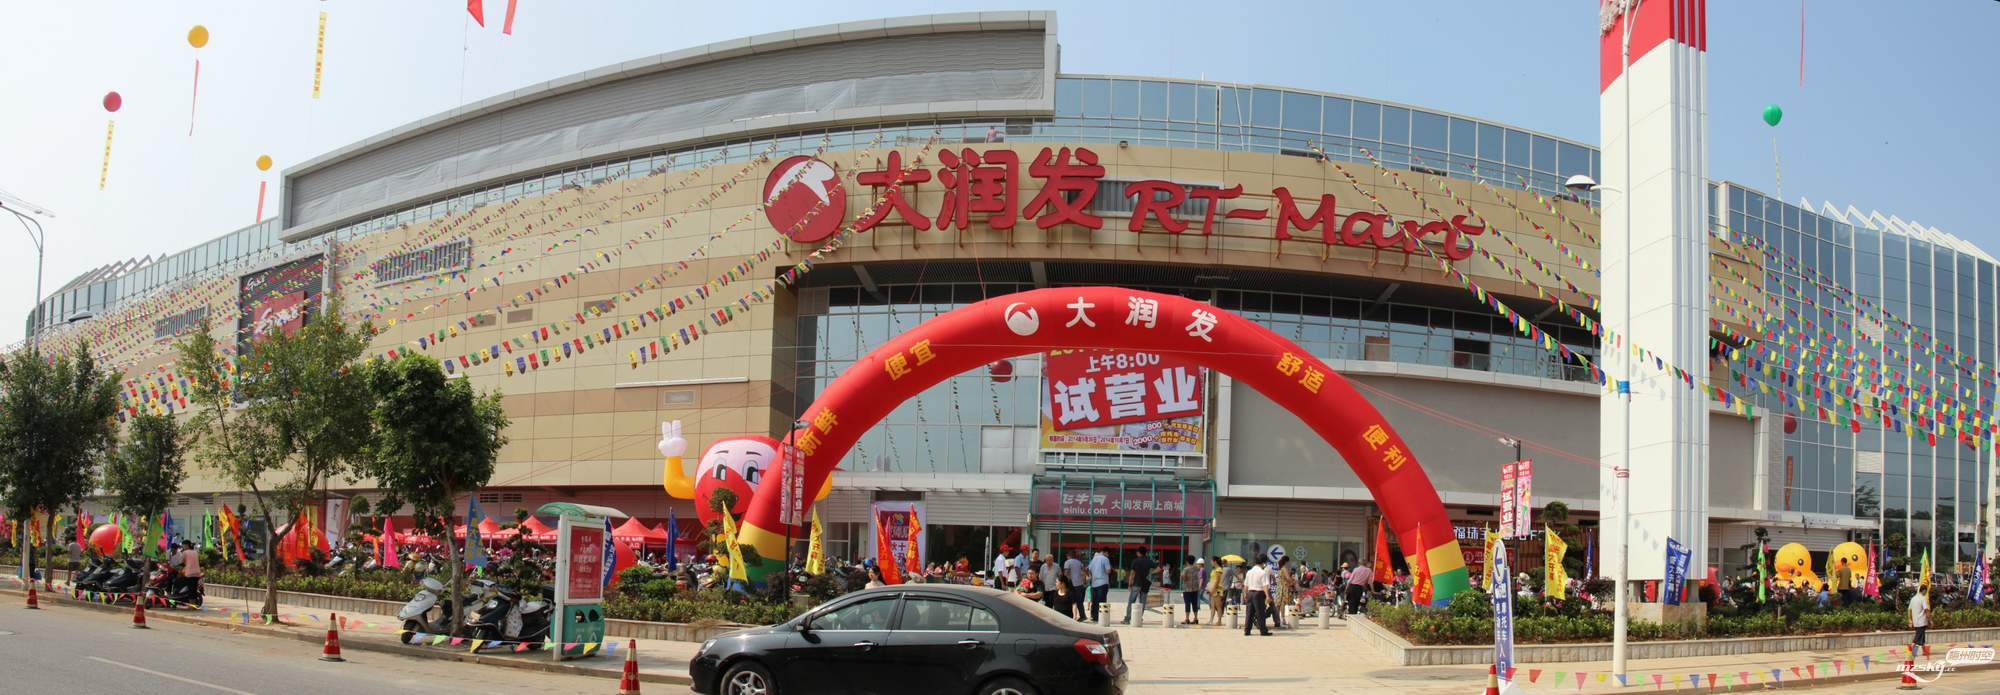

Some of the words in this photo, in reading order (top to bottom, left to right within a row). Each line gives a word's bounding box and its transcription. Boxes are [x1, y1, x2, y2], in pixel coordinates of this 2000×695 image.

[856, 147, 1105, 233] 大润发
[1125, 180, 1485, 260] RT-Mart
[1065, 295, 1218, 342] 大润发
[884, 339, 937, 382] 便宜
[1276, 352, 1325, 394] 舒适
[1054, 366, 1198, 426] 试营业
[795, 406, 839, 457] 新鲜
[1362, 424, 1407, 472] 便利
